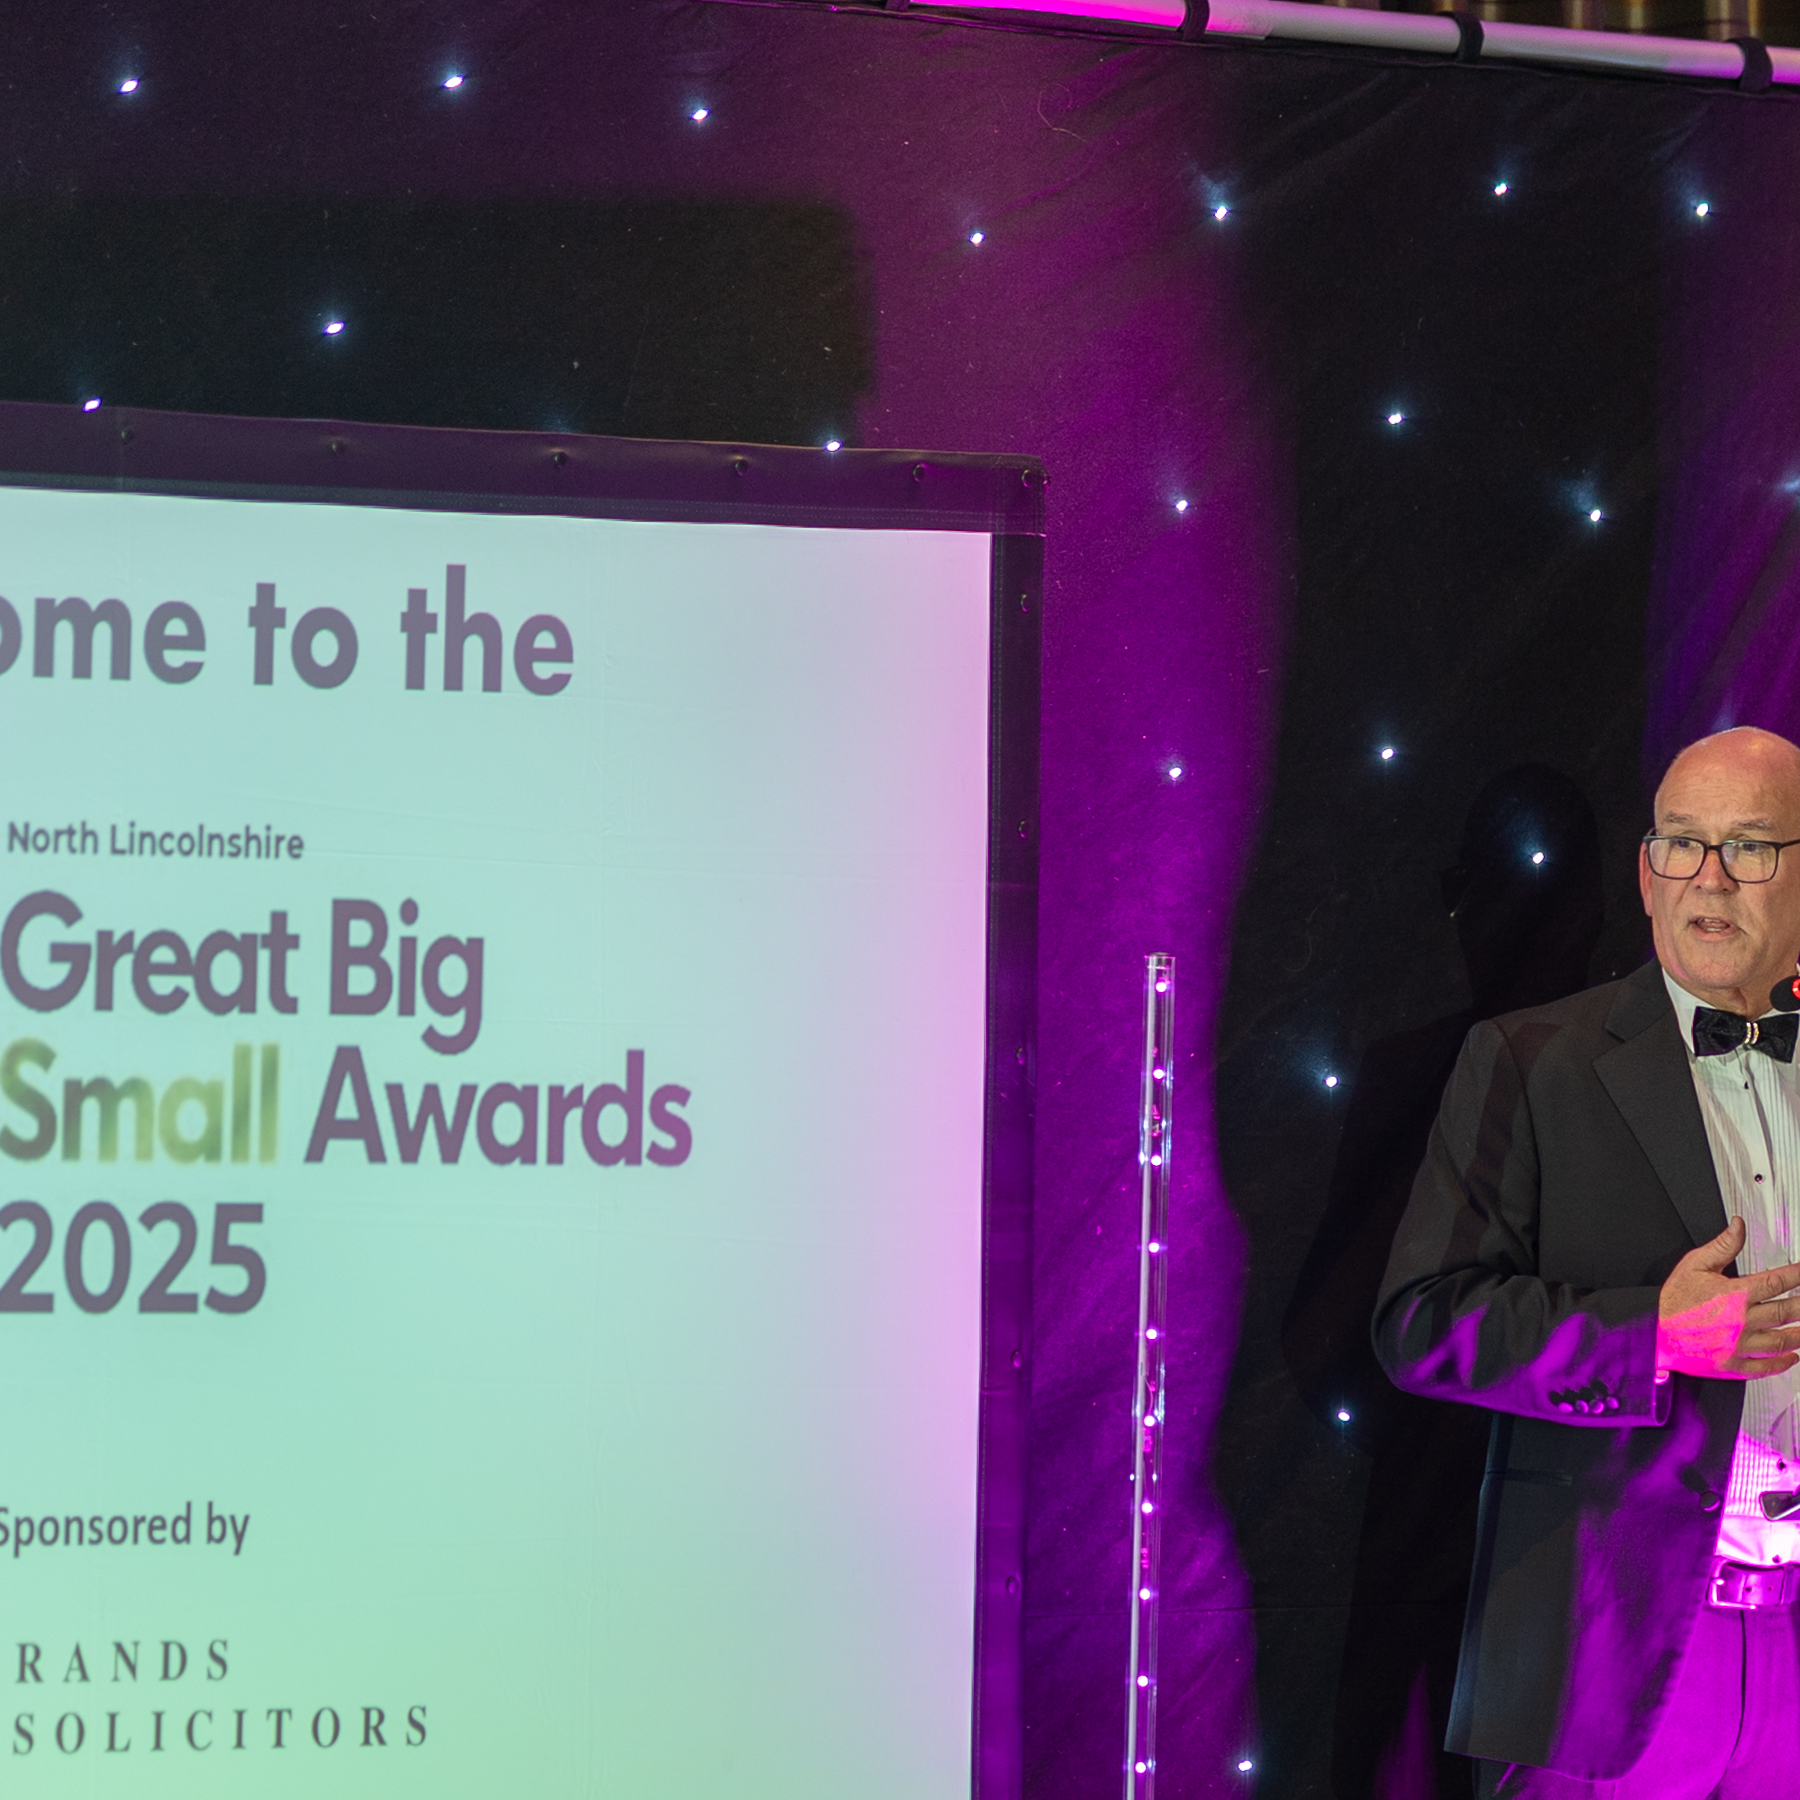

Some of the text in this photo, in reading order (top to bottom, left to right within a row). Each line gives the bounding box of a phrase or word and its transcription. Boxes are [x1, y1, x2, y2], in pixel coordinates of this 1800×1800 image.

[248, 582, 359, 690] to
[400, 564, 575, 697] the
[7, 820, 305, 860] North Lincolnshire
[329, 898, 485, 1056] Big
[303, 1045, 693, 1167] Awards
[206, 1501, 251, 1556] by
[16, 1639, 229, 1684] RANDS
[13, 1705, 428, 1755] SOLICITORS
